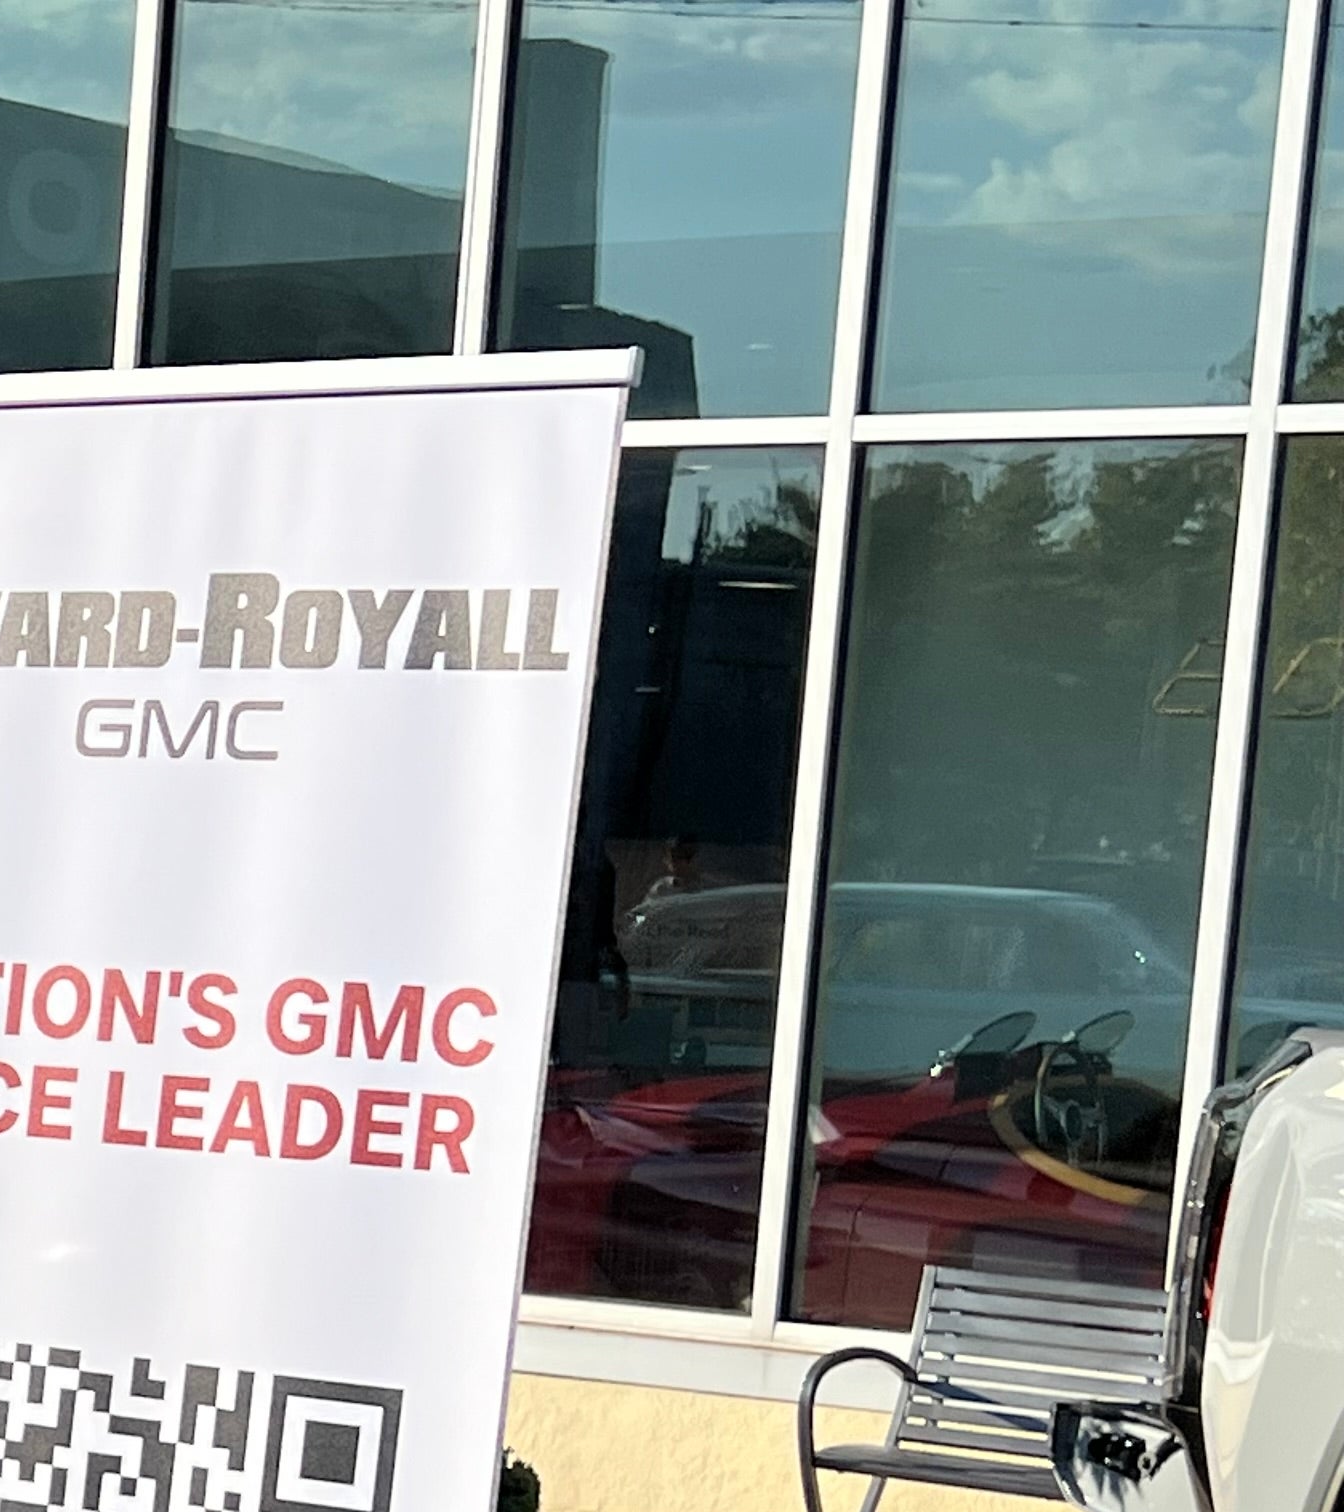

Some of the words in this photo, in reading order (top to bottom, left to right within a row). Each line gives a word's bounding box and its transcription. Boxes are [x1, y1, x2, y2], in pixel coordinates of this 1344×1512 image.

[75, 699, 283, 760] GMC
[266, 978, 497, 1067] GMC
[102, 1070, 474, 1174] LEADER
